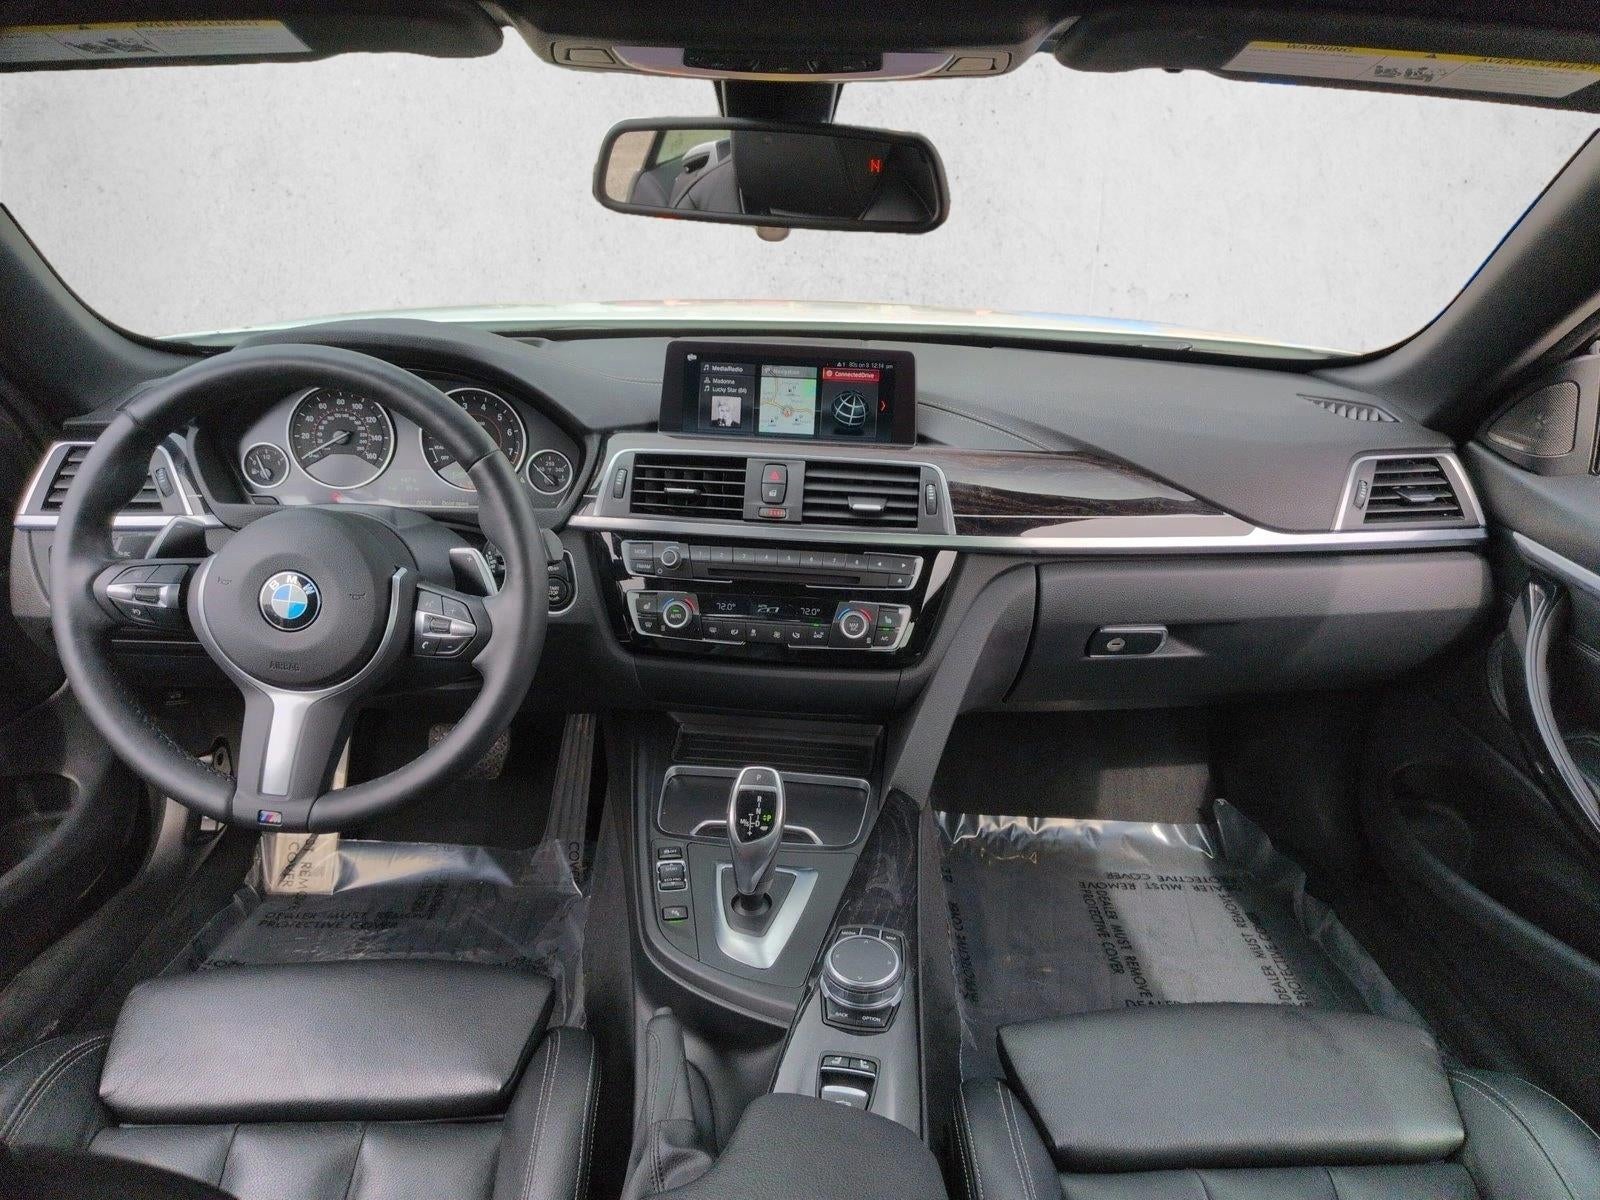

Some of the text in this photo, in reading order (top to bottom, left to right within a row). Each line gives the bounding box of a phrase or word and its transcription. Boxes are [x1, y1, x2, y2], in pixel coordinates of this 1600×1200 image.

[870, 159, 880, 173] N
[834, 371, 875, 379] ConnectedDrive
[480, 403, 487, 412] 4
[305, 415, 315, 423] 40
[365, 416, 378, 424] 120
[497, 413, 503, 421] 5
[301, 432, 311, 440] 20
[506, 428, 513, 437] 6
[370, 434, 383, 442] 140
[269, 574, 317, 596] BMW
[1079, 881, 1137, 891] REMOVE
[1145, 881, 1182, 891] MUST
[861, 1014, 881, 1023] OPTION
